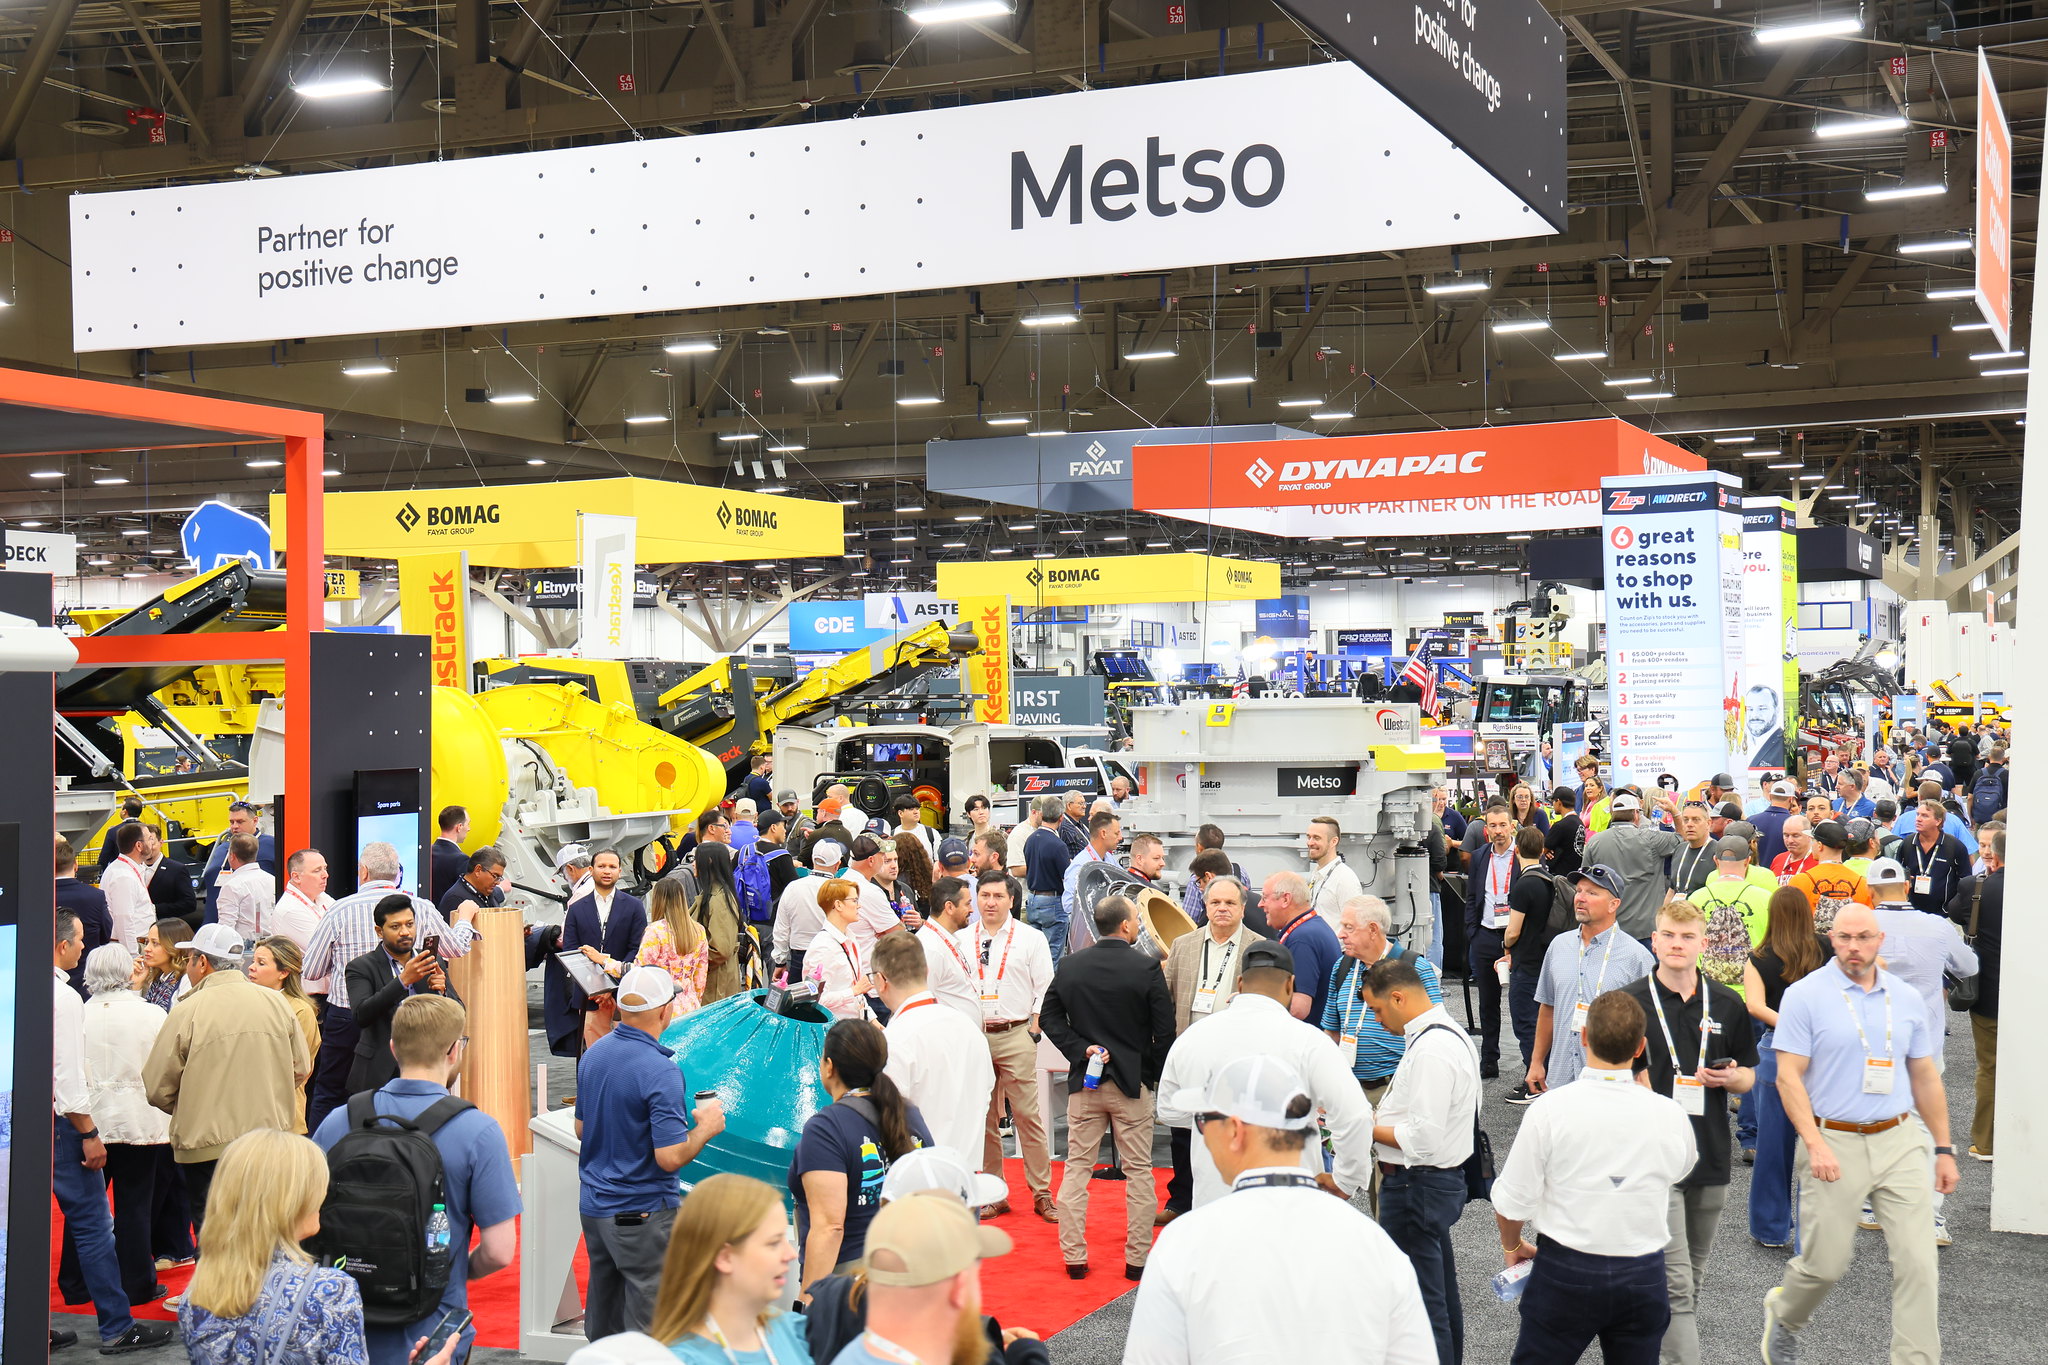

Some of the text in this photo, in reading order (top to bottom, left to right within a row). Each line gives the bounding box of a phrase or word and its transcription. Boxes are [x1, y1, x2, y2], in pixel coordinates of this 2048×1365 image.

[1415, 5, 1501, 113] positive change
[1010, 136, 1286, 230] Metso
[258, 217, 395, 254] Partner for
[258, 253, 459, 298] positive change
[1070, 460, 1124, 476] FAYAT
[1278, 451, 1487, 482] DYNAPAC
[1278, 482, 1331, 491] FAYAT GROUP
[1310, 489, 1601, 515] YOUR PARTNER ON THE ROAD
[1652, 492, 1703, 505] AWDIRECT
[427, 504, 500, 526] BOMAG
[736, 508, 777, 529] BOMAG
[1615, 527, 1694, 549] 6 great
[5, 545, 47, 563] DECK
[1616, 552, 1696, 566] reasons
[1048, 568, 1100, 582] BOMAG
[1234, 570, 1252, 584] BOMAG
[1616, 570, 1693, 590] to shop
[1617, 592, 1696, 609] with us.
[1258, 610, 1295, 618] SIGNAL
[814, 616, 855, 634] CDE
[1178, 631, 1197, 641] ASTEC
[981, 605, 1003, 724] Keestrack
[1619, 652, 1625, 663] 1
[1618, 673, 1627, 684] 2
[1619, 693, 1627, 704] 3
[680, 709, 700, 722] Keestrack
[1016, 713, 1061, 724] PAVING
[1619, 714, 1628, 725] 4
[1492, 723, 1522, 732] RimSling
[1620, 735, 1629, 746] 5
[1621, 756, 1629, 767] 6
[1055, 778, 1090, 787] AWDIRECT
[1297, 774, 1341, 789] Metso
[377, 801, 389, 809] Spare
